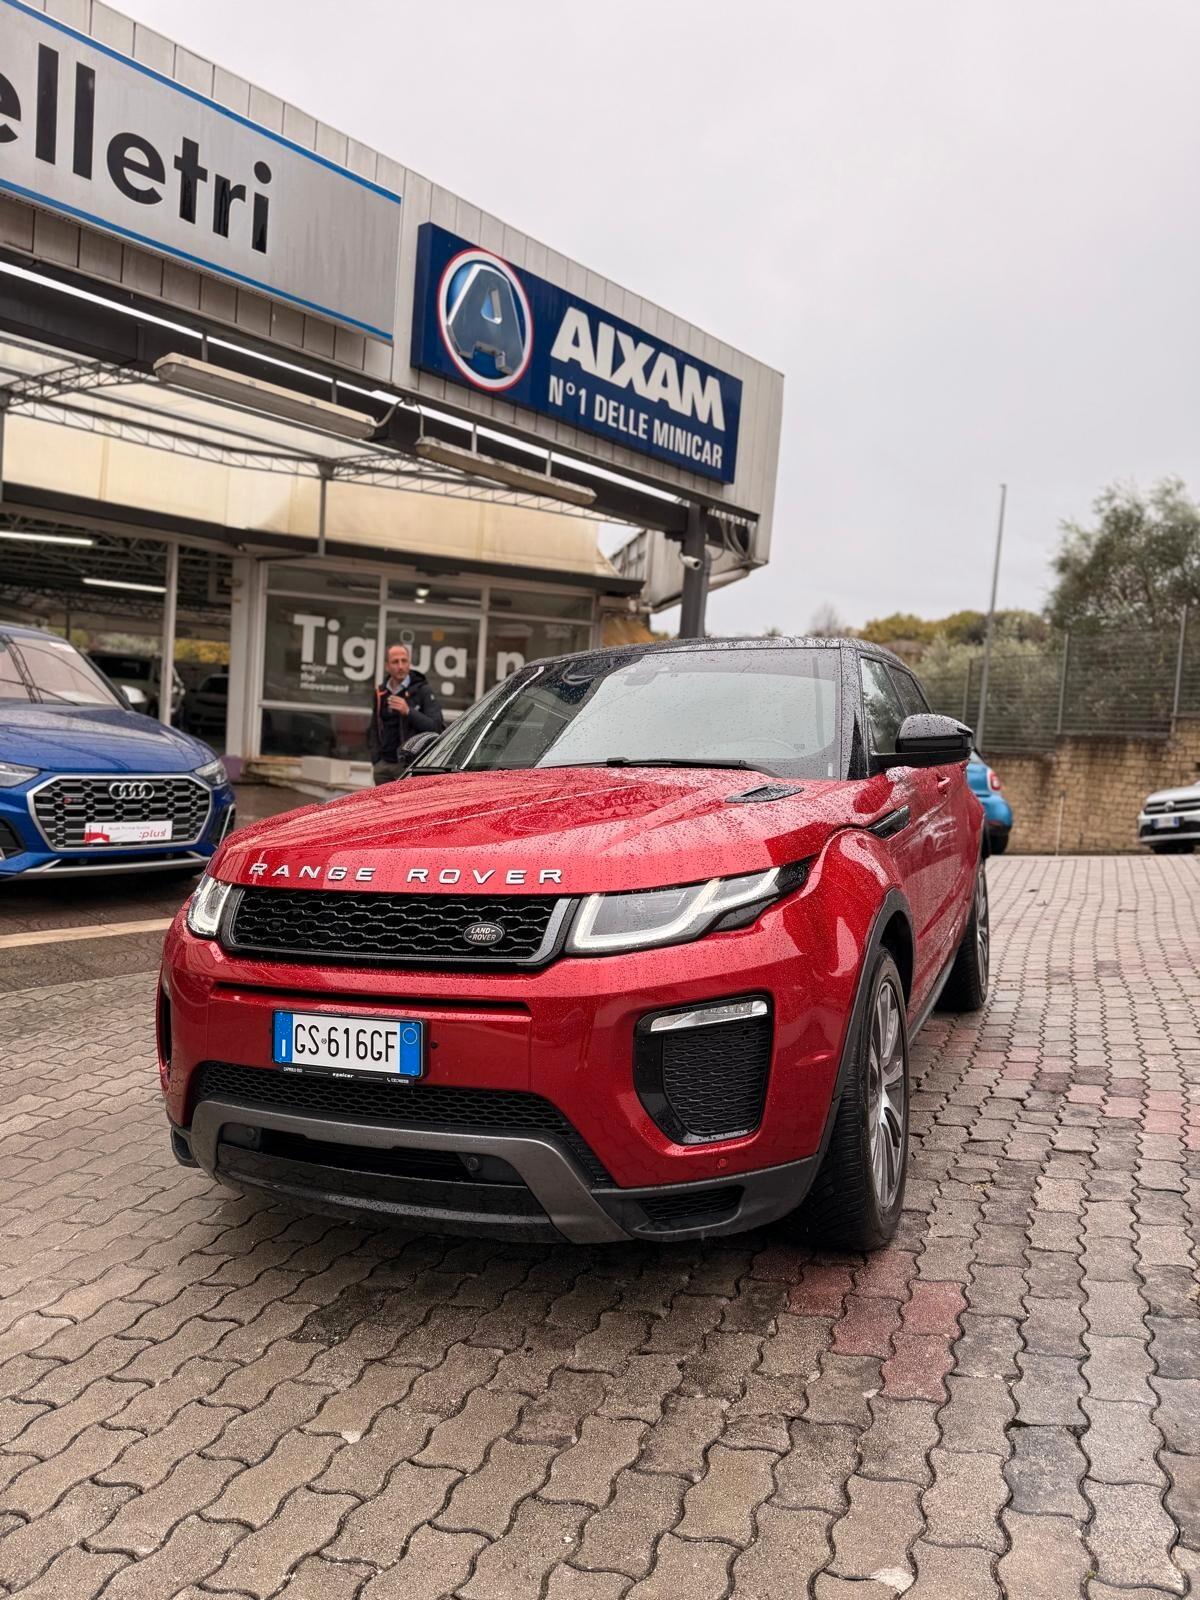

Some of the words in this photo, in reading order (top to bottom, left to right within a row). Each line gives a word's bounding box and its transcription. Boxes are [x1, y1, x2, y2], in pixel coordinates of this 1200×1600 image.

[550, 306, 726, 432] AIXAM
[594, 394, 648, 439] DELLE
[652, 419, 723, 469] MINICAR
[249, 863, 376, 881] RANGE
[406, 868, 563, 885] ROVER
